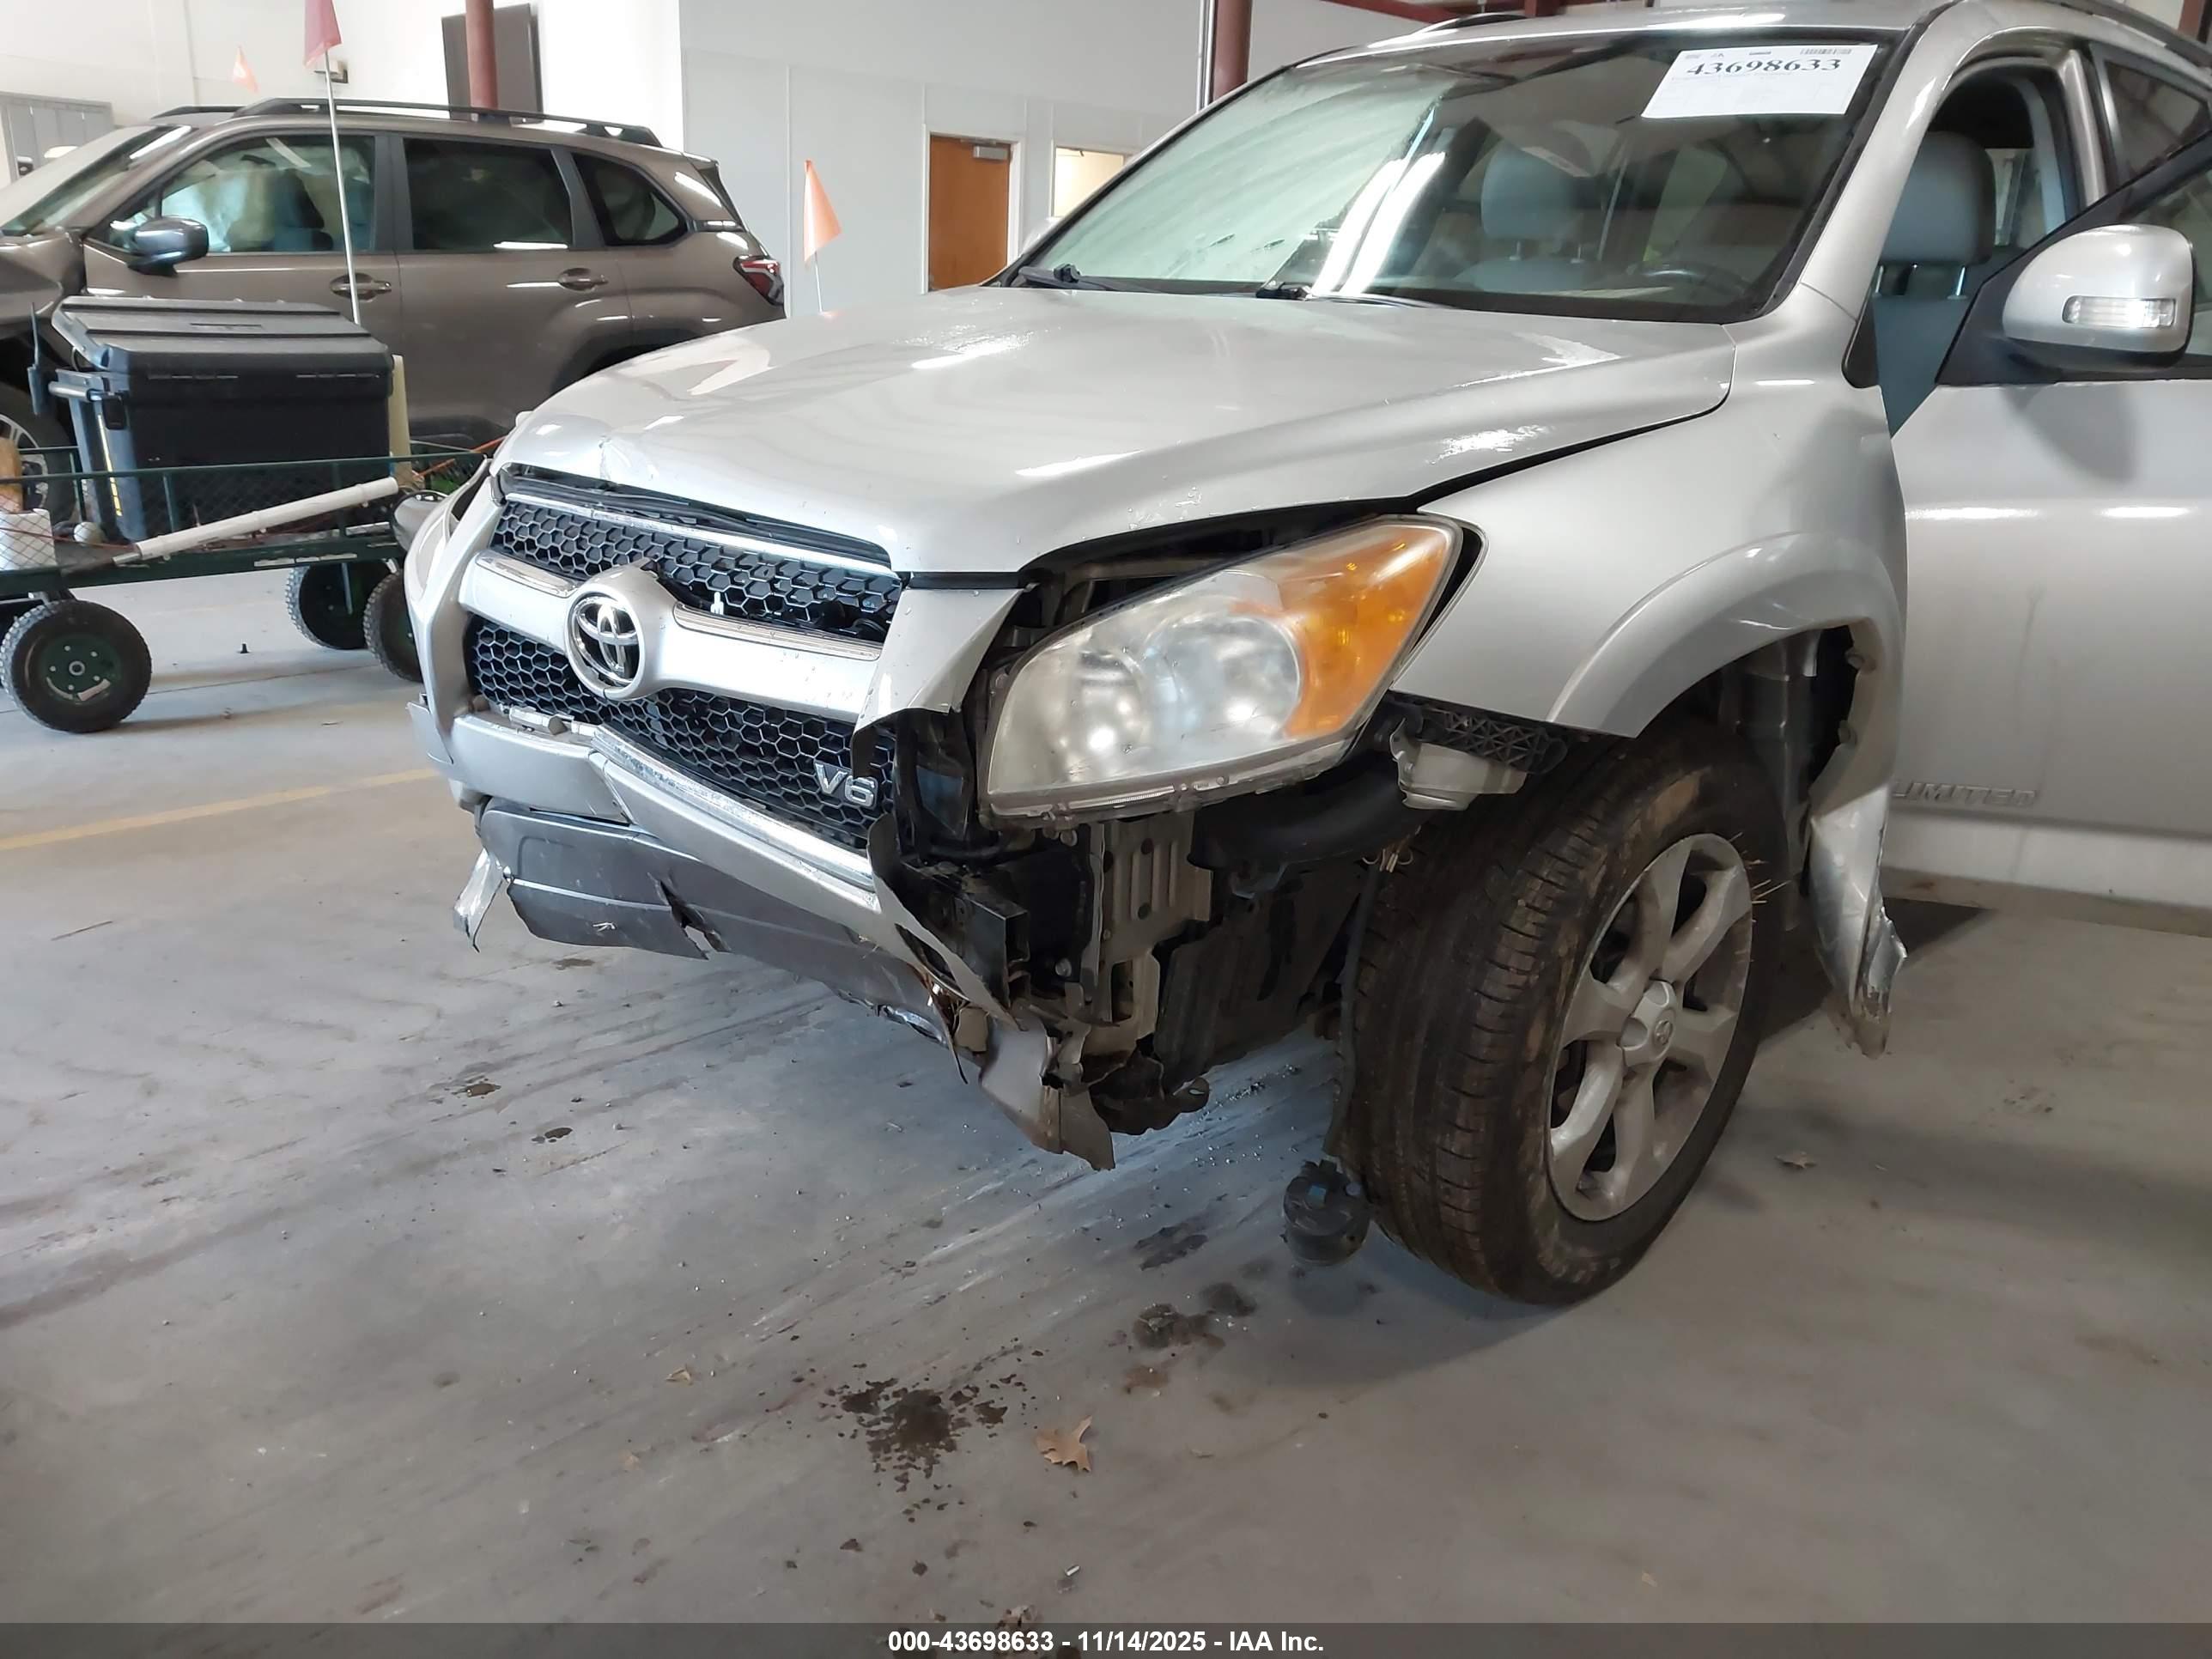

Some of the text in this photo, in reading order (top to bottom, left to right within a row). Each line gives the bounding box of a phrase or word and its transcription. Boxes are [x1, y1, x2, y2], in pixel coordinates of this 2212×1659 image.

[1686, 58, 1843, 76] 43698633
[813, 762, 877, 808] V6
[1892, 781, 2037, 807] LIMITED
